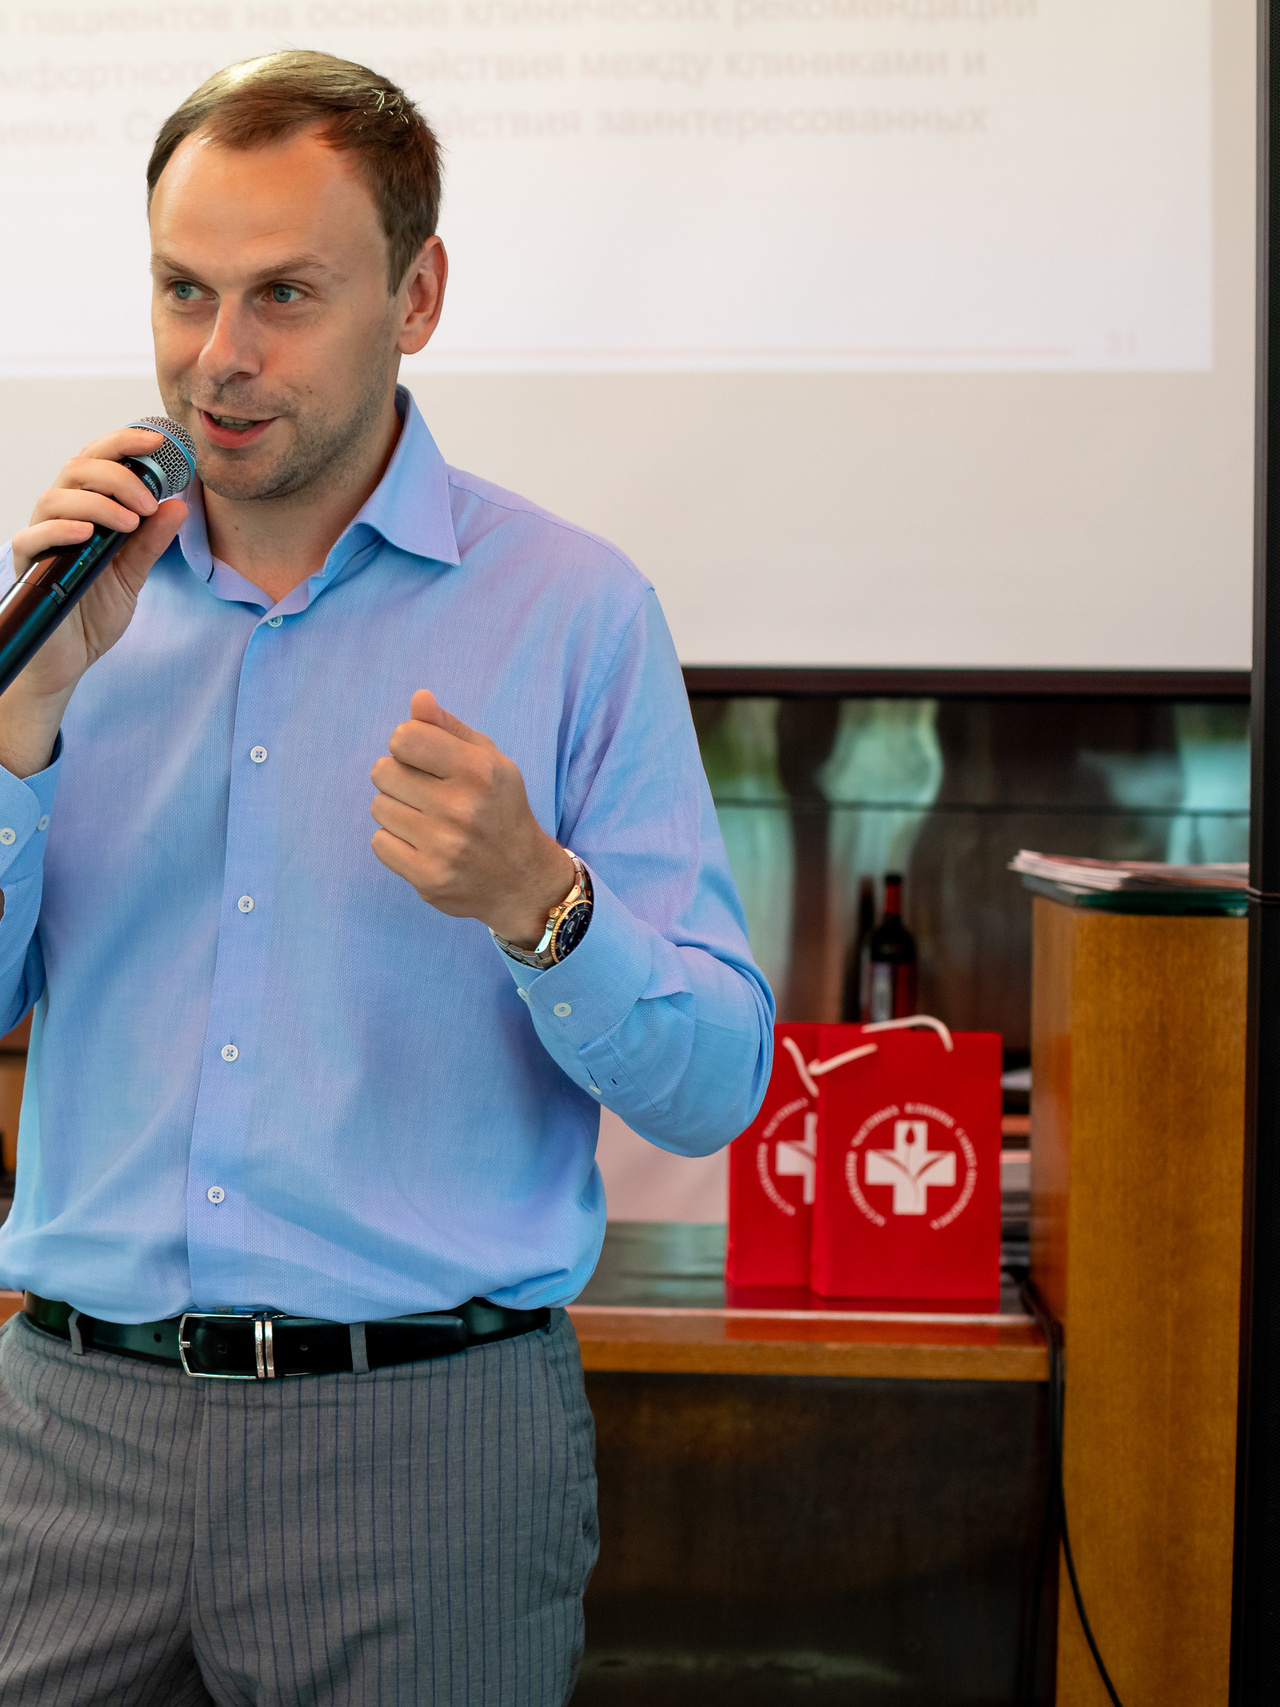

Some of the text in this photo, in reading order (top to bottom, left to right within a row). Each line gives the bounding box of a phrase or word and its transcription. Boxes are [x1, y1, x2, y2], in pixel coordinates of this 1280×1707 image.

[20, 5, 232, 40] пациентов
[246, 5, 293, 29] на
[307, 3, 449, 29] основе
[462, 0, 719, 27] клинических
[579, 52, 712, 88] между
[724, 48, 949, 79] клиниками
[963, 49, 988, 76] и
[594, 105, 989, 144] заинтересованных
